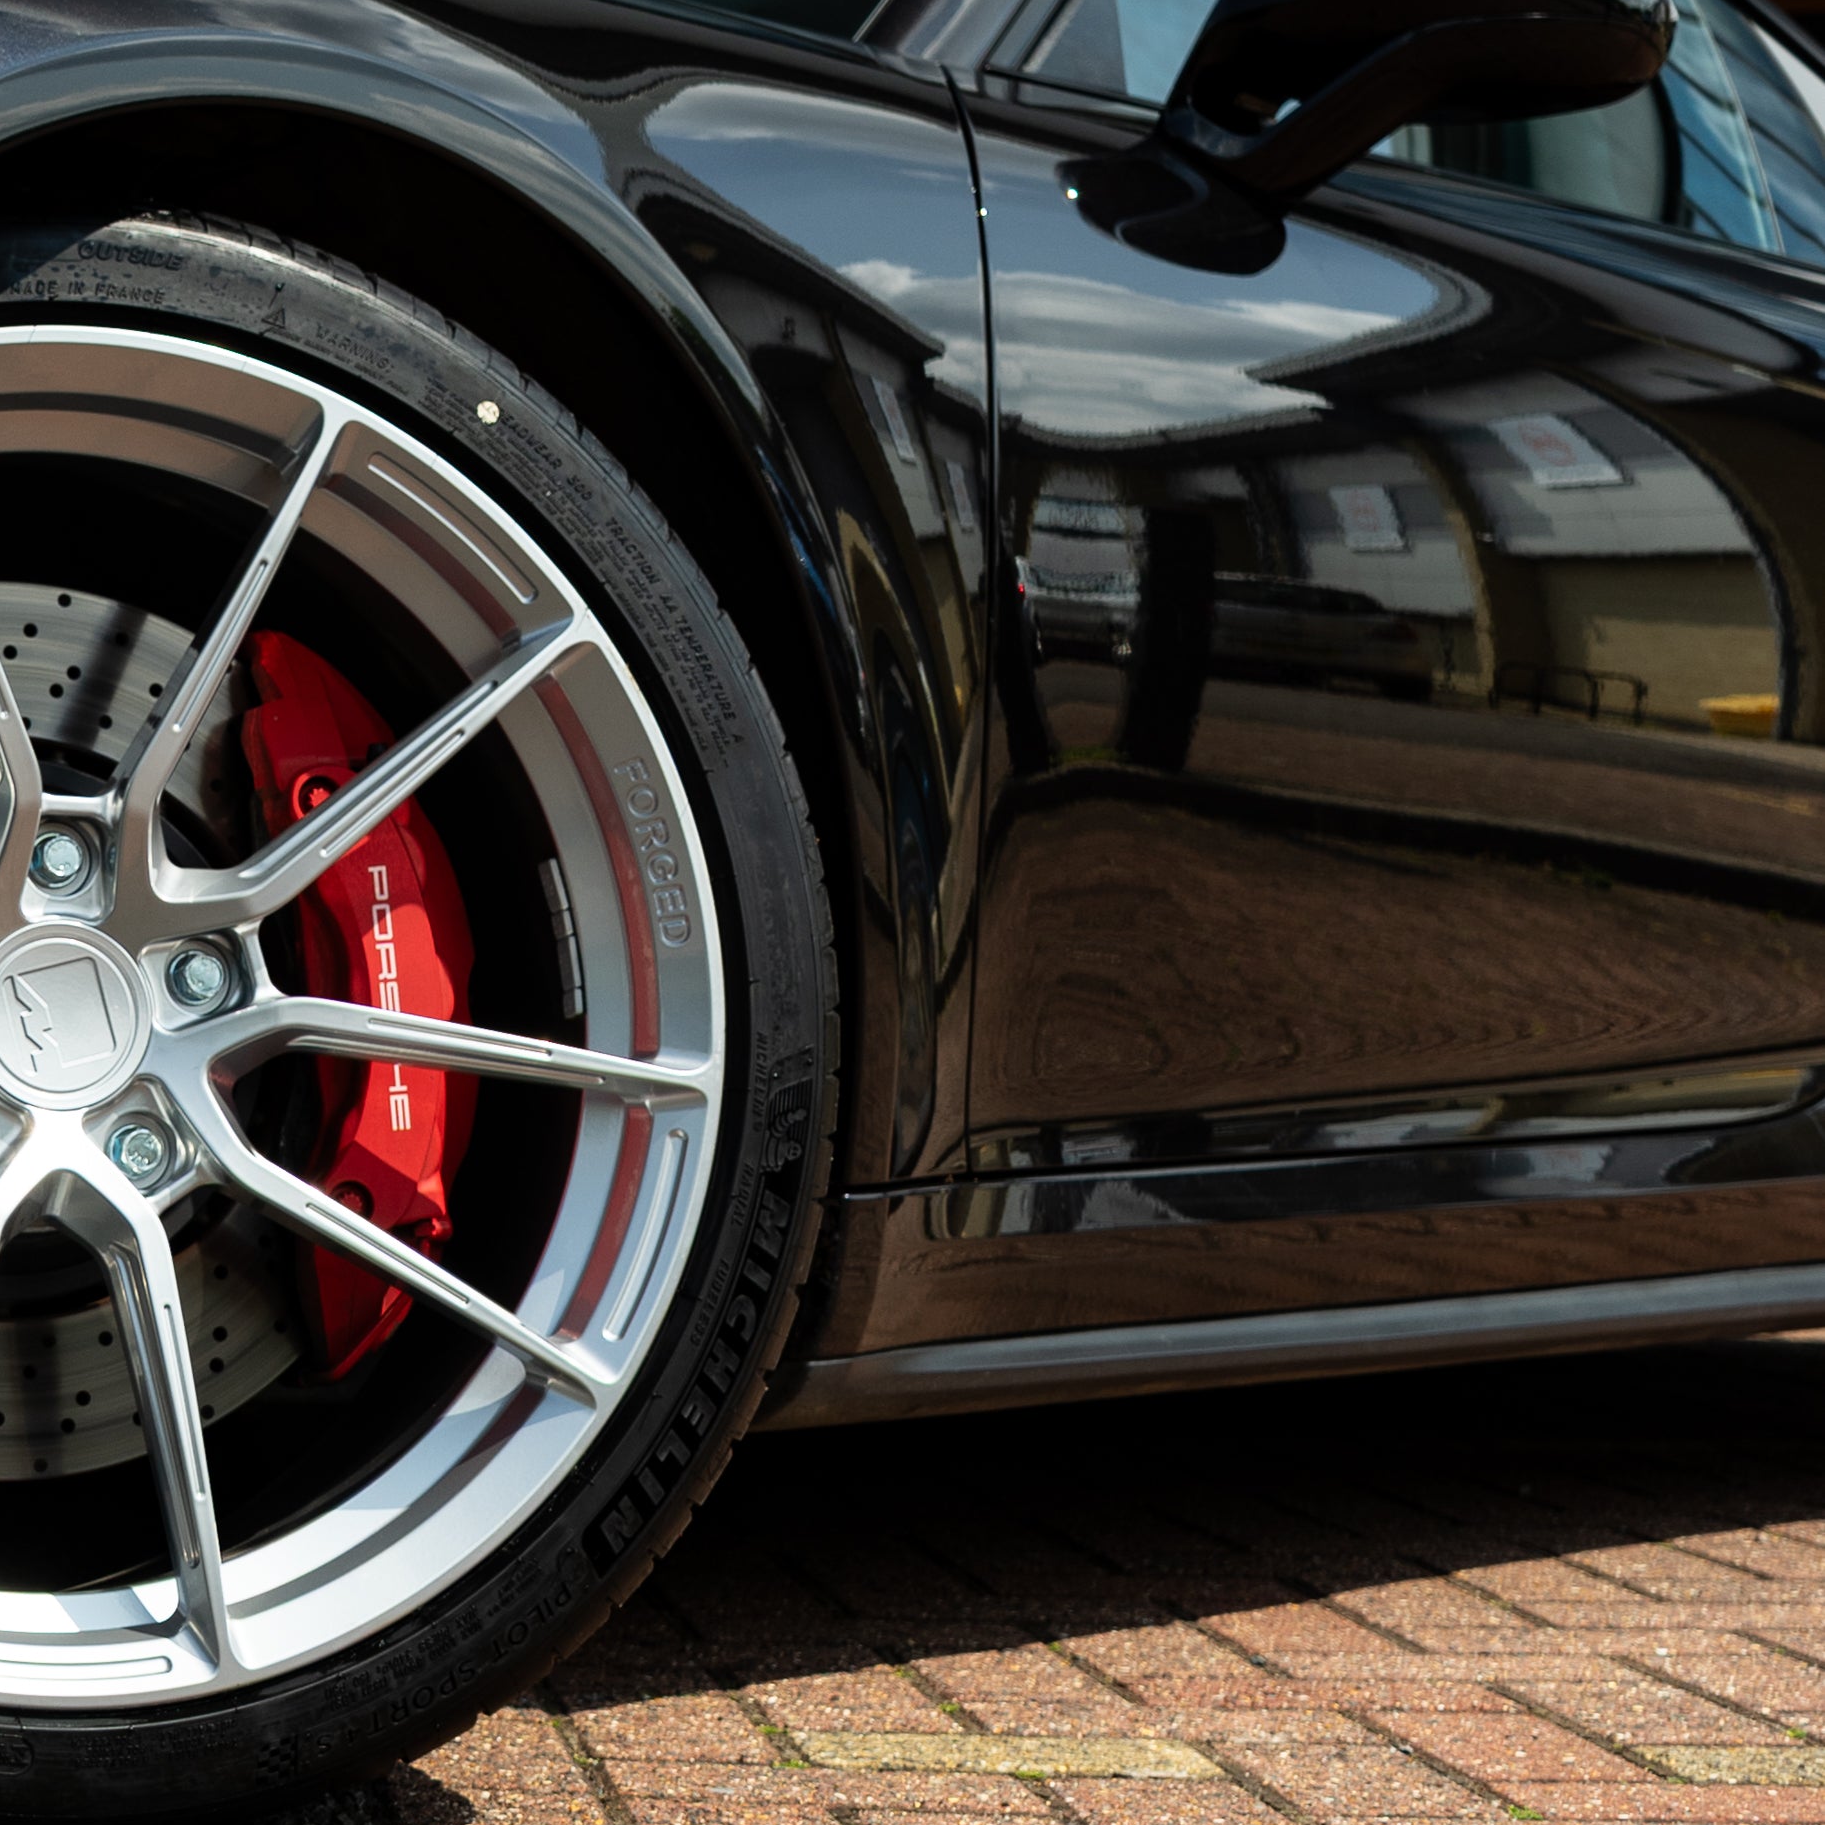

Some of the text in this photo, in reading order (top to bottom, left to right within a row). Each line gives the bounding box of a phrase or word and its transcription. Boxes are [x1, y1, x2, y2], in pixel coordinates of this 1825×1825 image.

[14, 279, 167, 305] MADE IN FRANCE
[78, 241, 185, 272] OUTSIDE
[604, 516, 662, 587] TRACTION
[657, 588, 681, 615] AA
[676, 615, 737, 722] TEMPERATURE
[614, 757, 691, 948] FORGED
[368, 865, 412, 1131] PORSHE
[599, 1190, 791, 1555] MICHELIN
[490, 1582, 573, 1665] PILOT
[366, 1664, 476, 1737] SPORT
